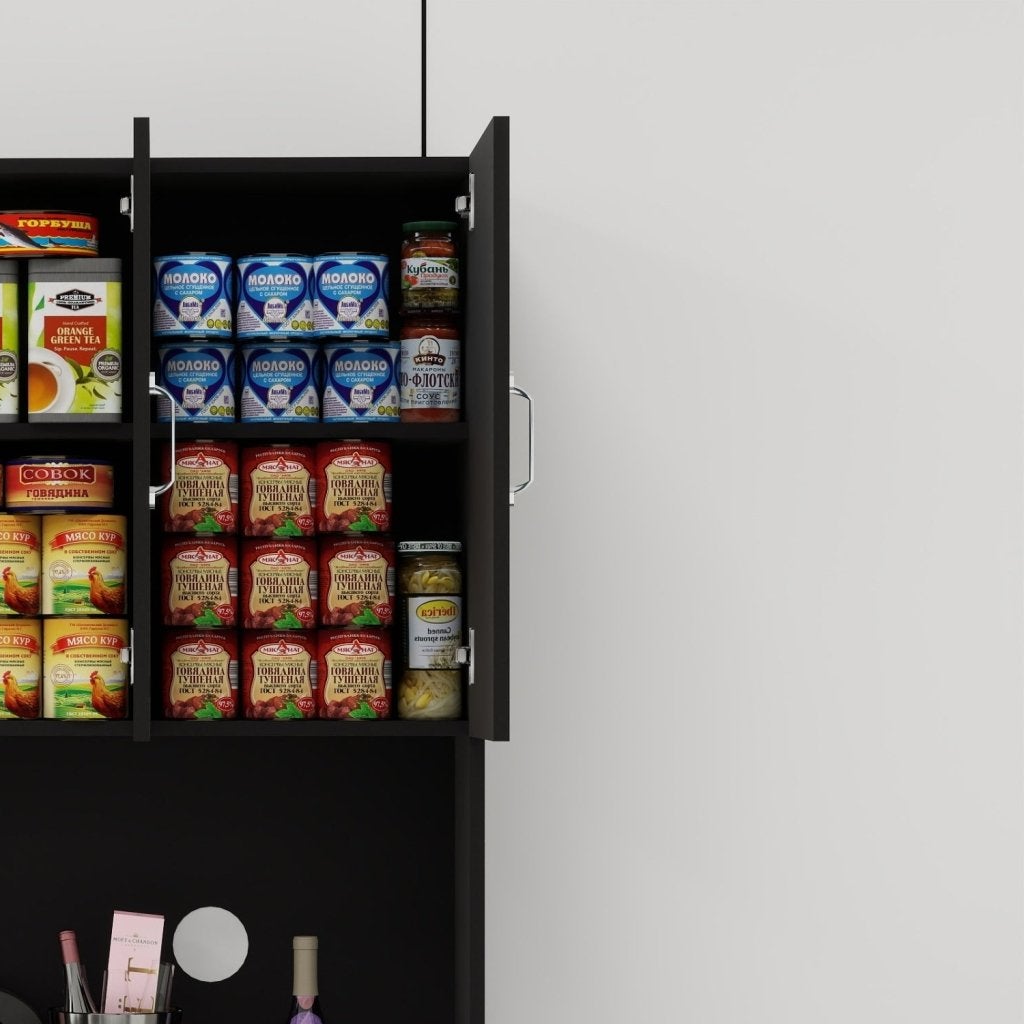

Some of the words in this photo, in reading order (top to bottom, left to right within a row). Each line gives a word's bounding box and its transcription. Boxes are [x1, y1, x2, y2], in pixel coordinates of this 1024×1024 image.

[17, 220, 94, 231] ГОРБУША
[407, 262, 449, 276] Кубань
[164, 272, 216, 284] МОЛОКО
[249, 274, 302, 285] МОЛОКО
[322, 272, 374, 284] МОЛОКО
[57, 328, 94, 336] ORANGE
[167, 360, 220, 371] МОЛОКО
[335, 360, 388, 371] МОЛОКО
[24, 467, 91, 480] СОВОК
[256, 485, 304, 493] ГОВЯДИНА
[331, 480, 380, 488] ГОВЯДИНА
[26, 489, 88, 498] ГОВЯДИНА
[65, 532, 96, 542] МЯСО
[99, 532, 118, 542] КУР
[256, 577, 304, 585] ГОВЯДИНА
[334, 574, 382, 582] ГОВЯДИНА
[178, 582, 222, 590] ТУШЕНАЯ
[336, 582, 382, 590] ТУШЕНАЯ
[13, 636, 32, 646] КУР
[257, 667, 306, 675] ГОВЯДИНА
